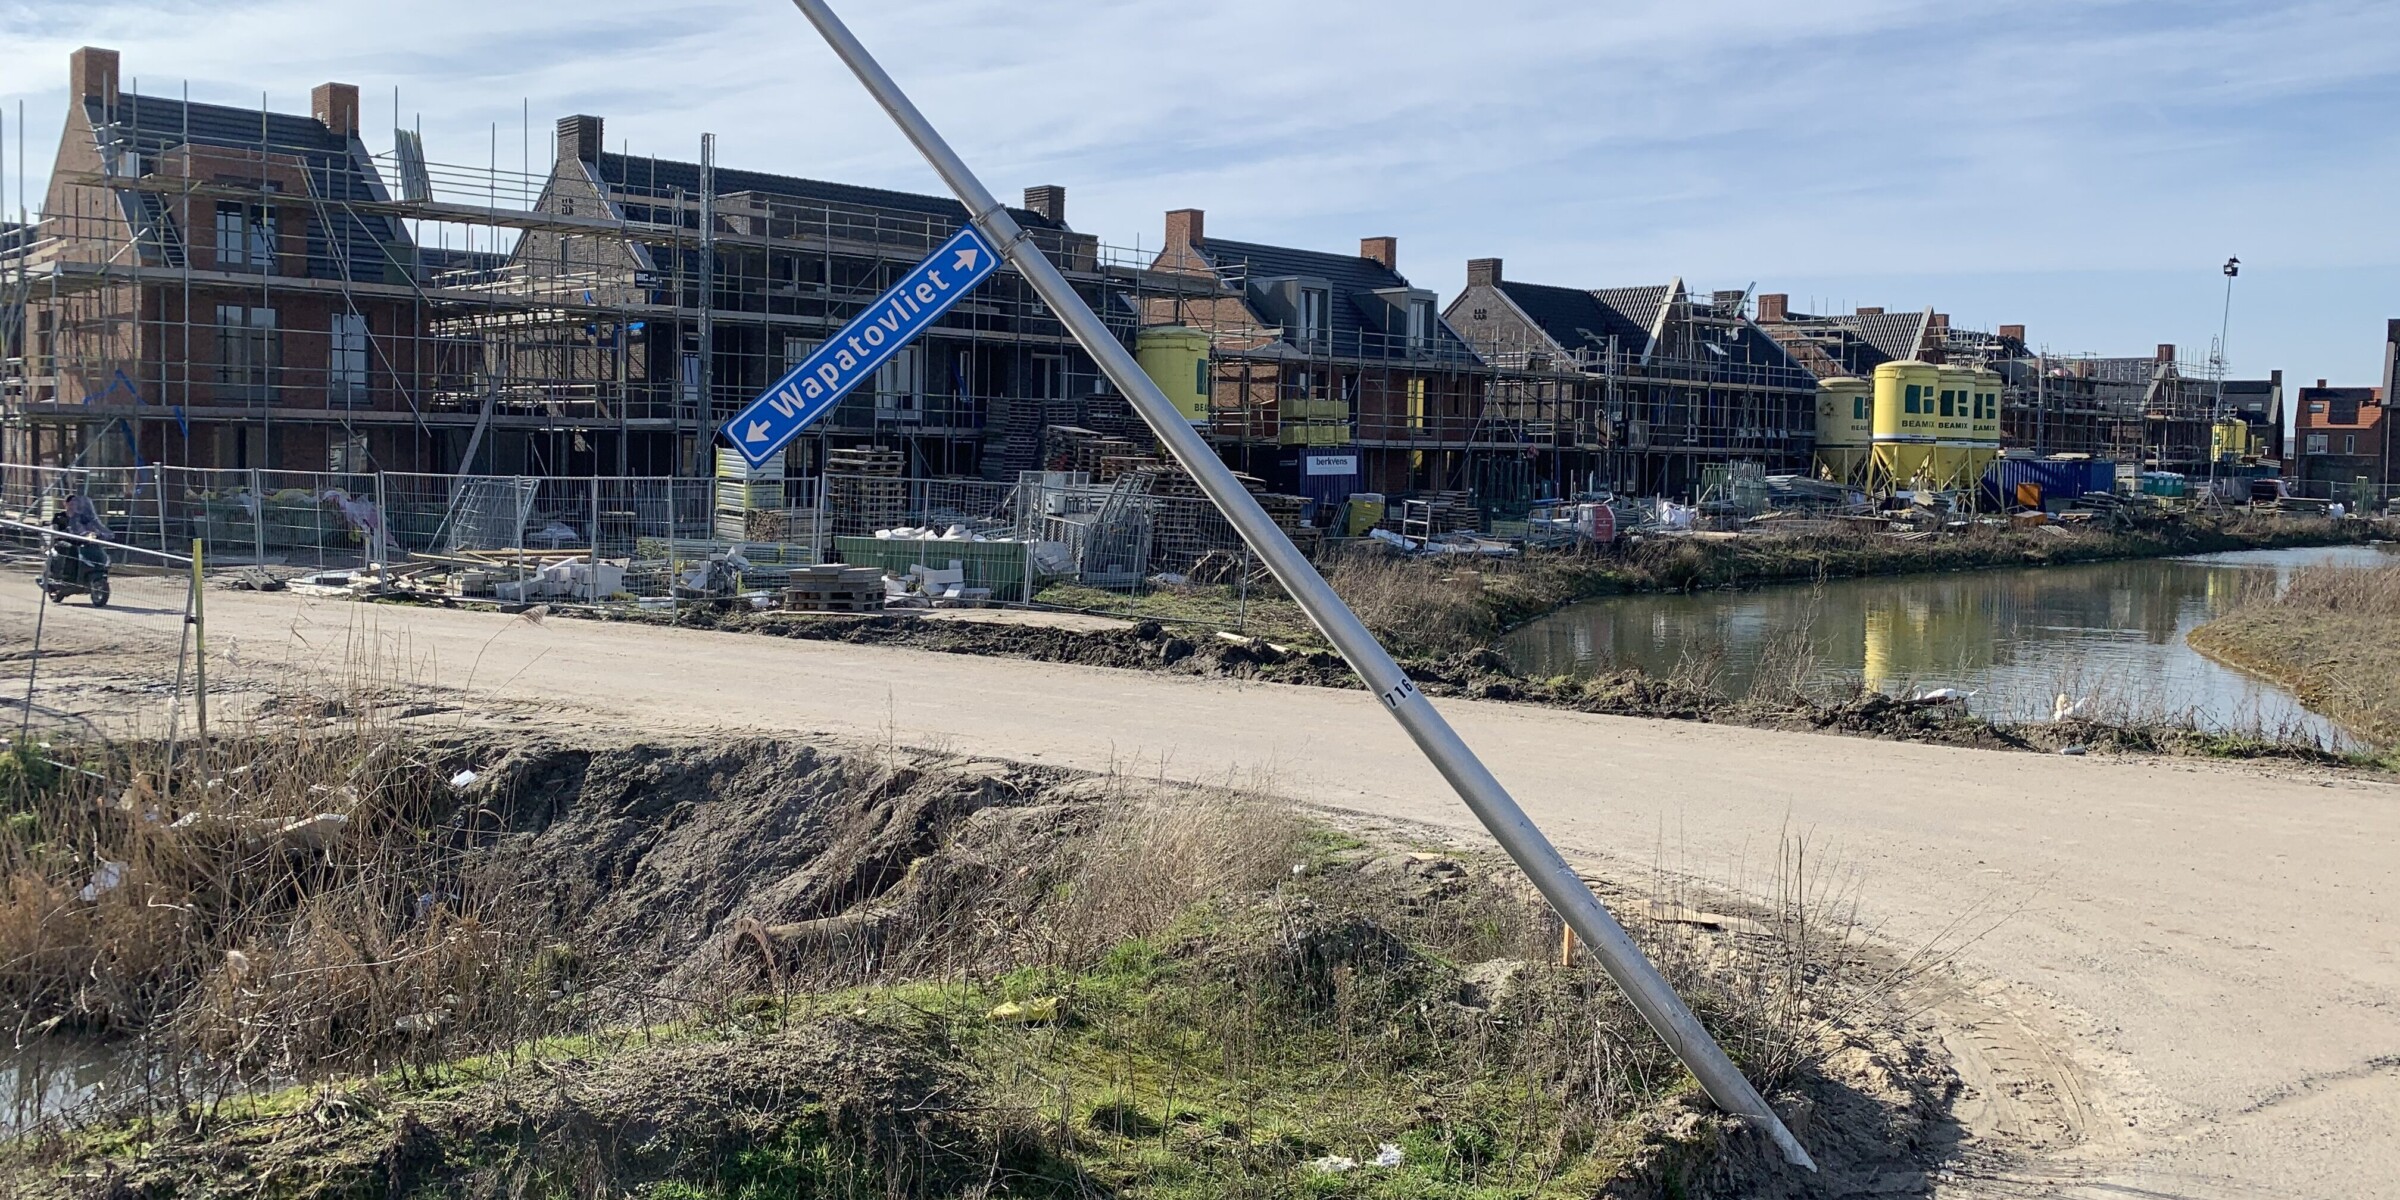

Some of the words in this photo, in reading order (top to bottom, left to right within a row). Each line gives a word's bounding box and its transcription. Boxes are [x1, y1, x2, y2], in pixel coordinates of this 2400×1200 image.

[768, 268, 950, 419] Wapatovliet
[1902, 420, 1935, 428] BEAMIX
[1316, 457, 1348, 465] berkvens
[1385, 679, 1413, 707] 716
